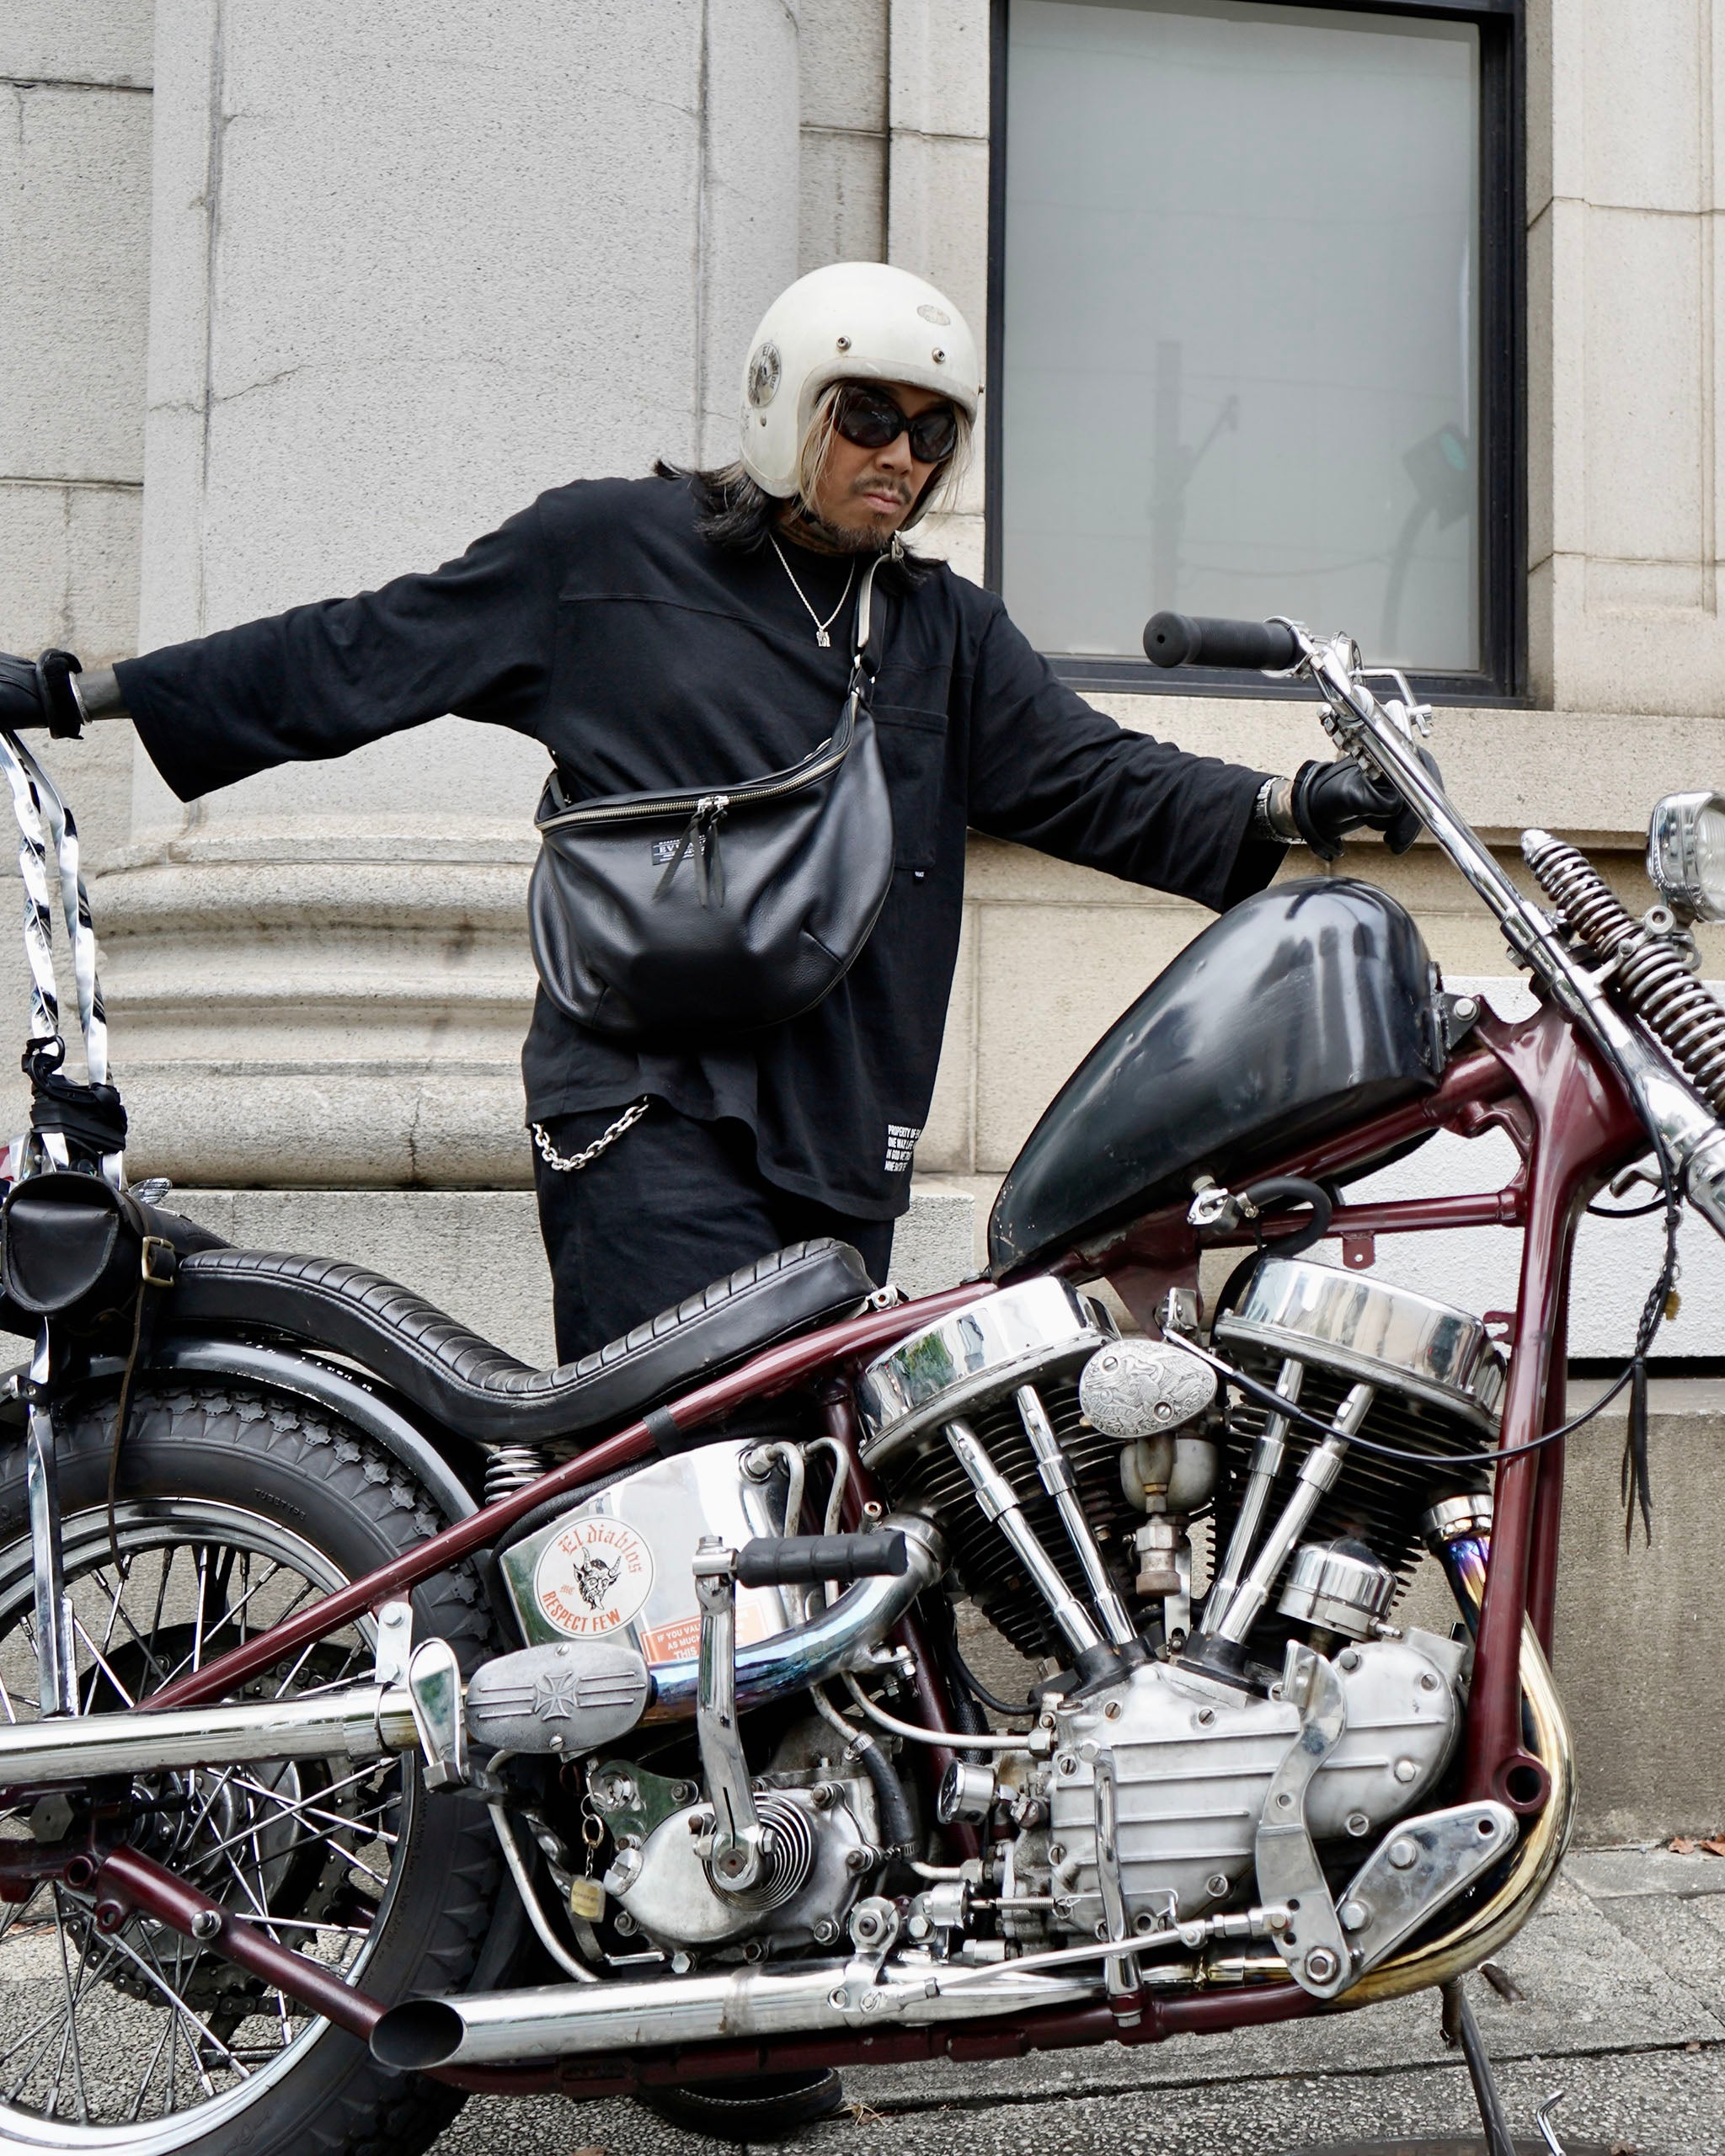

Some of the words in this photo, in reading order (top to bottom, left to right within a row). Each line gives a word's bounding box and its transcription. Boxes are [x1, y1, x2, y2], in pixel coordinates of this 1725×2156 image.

[888, 1124, 911, 1139] PROPERTY
[558, 1529, 584, 1556] El
[587, 1524, 644, 1574] diablos
[542, 1591, 588, 1632] RESPECT
[592, 1609, 621, 1632] FEW
[657, 1635, 665, 1643] IF
[665, 1630, 683, 1640] YOU
[683, 1624, 701, 1635] VAL
[668, 1641, 679, 1651] AS
[674, 1646, 697, 1660] THIS
